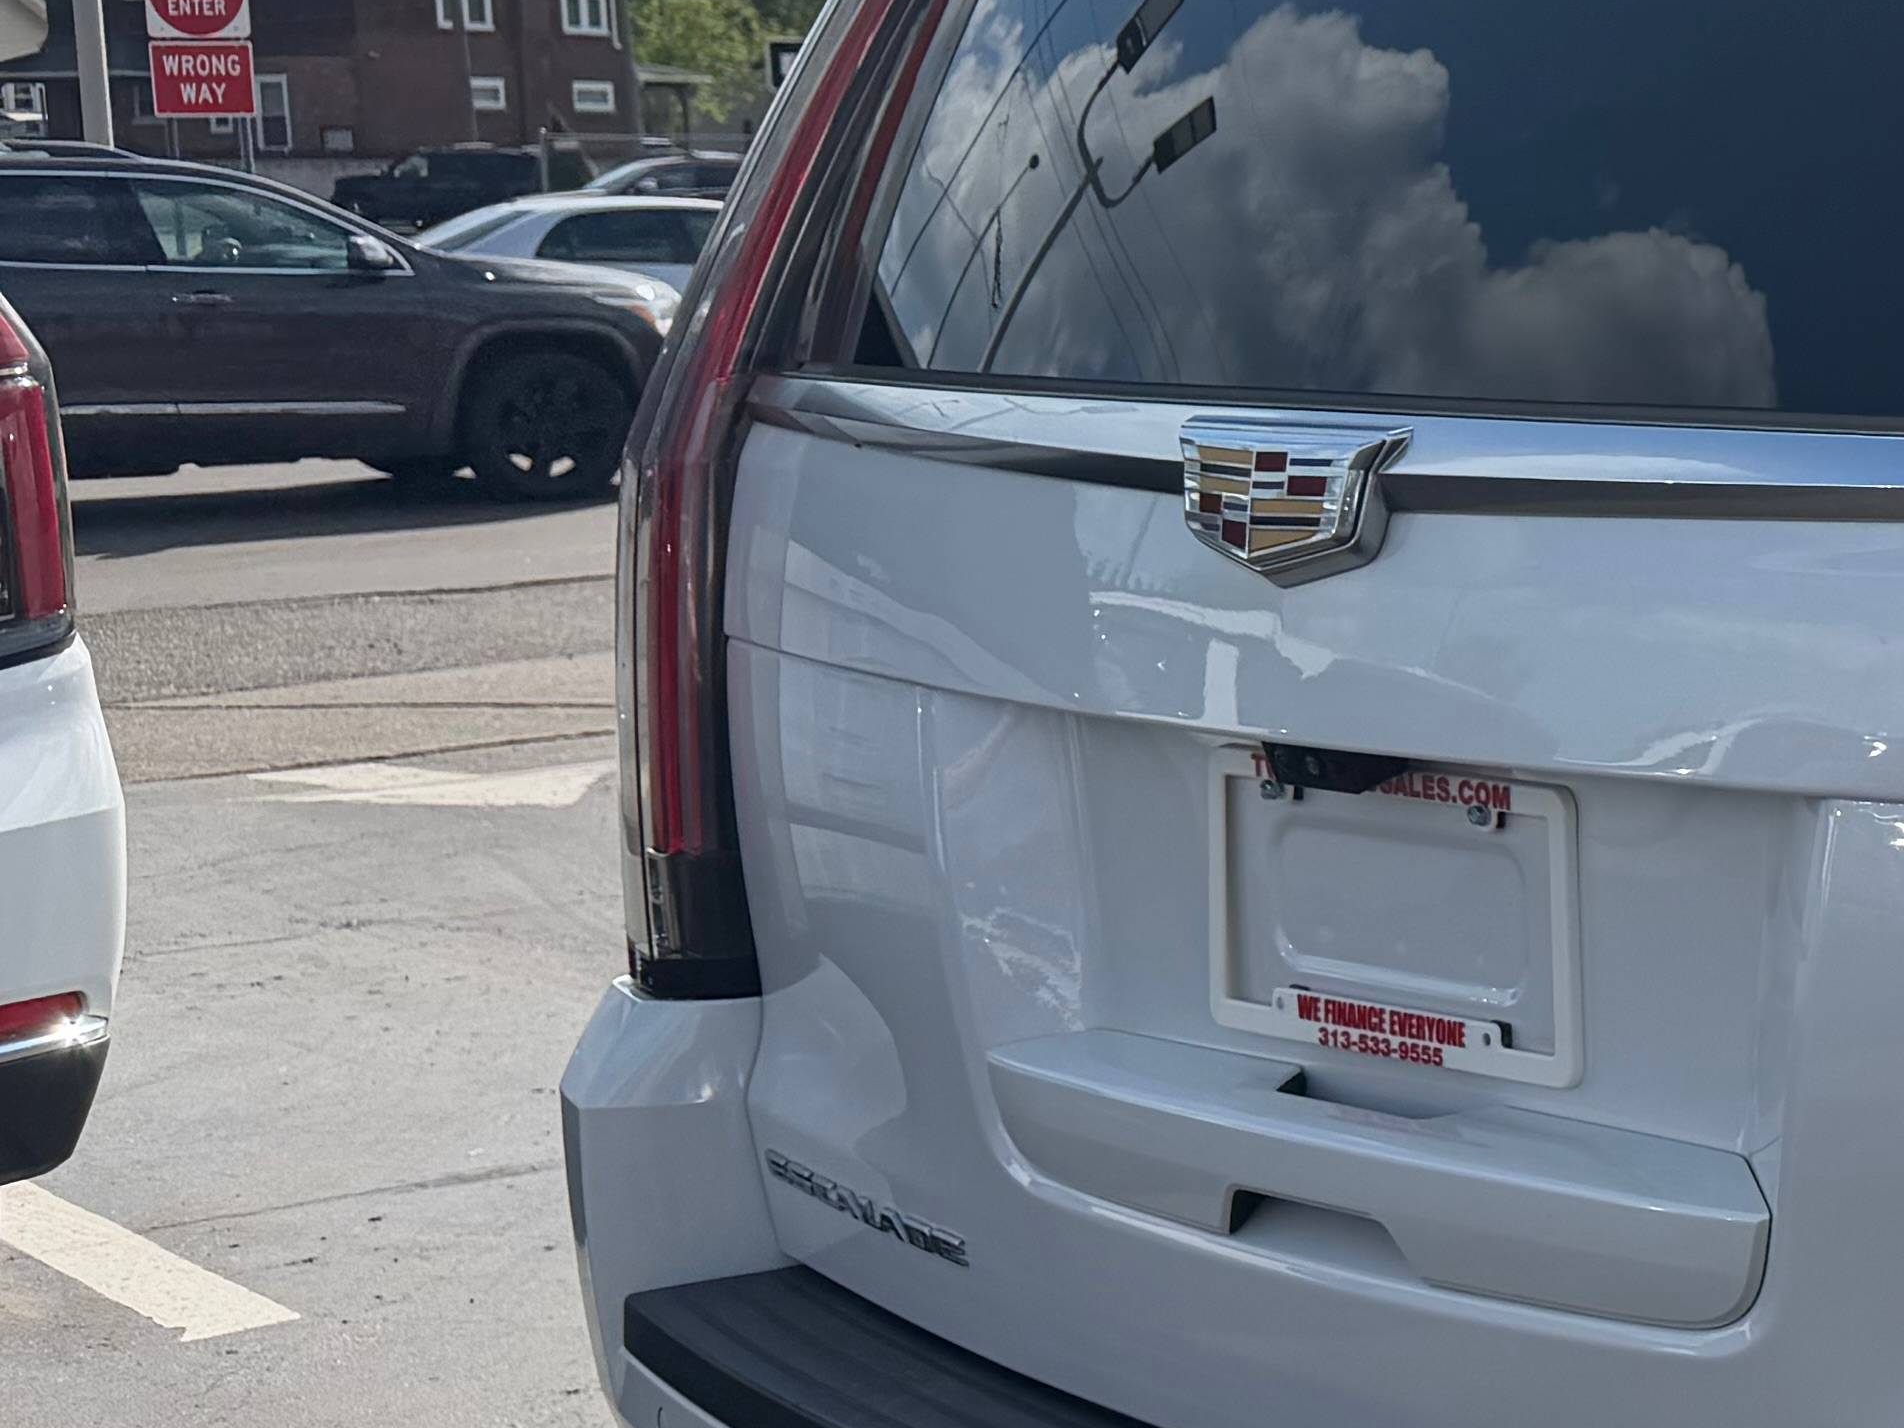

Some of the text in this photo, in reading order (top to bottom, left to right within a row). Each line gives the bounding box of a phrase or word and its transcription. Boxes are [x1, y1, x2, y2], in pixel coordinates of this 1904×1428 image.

[162, 54, 241, 77] WRONG
[180, 82, 226, 105] WAY
[1296, 993, 1466, 1049] WE FINANCE EVERYONE
[1318, 1026, 1444, 1068] 313-533-9555
